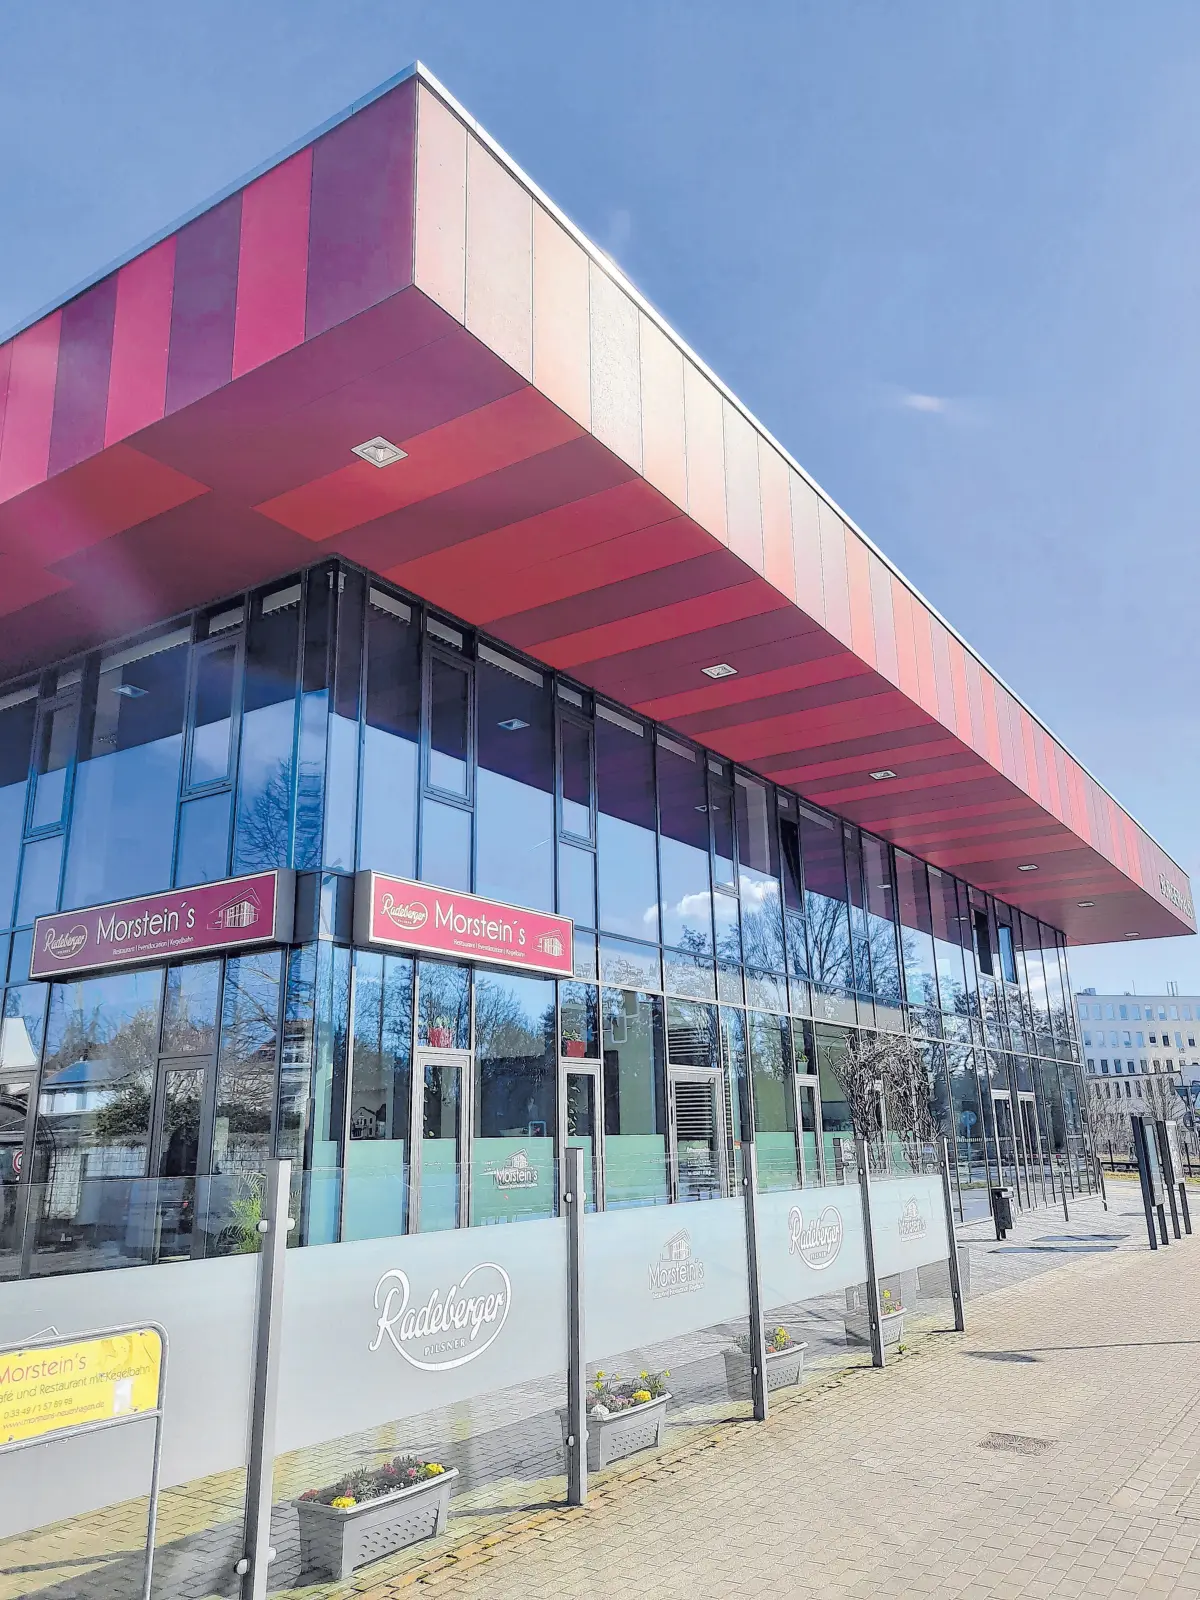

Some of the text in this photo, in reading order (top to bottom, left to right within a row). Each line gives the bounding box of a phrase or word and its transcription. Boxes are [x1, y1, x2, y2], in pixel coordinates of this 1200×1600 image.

[788, 1205, 843, 1270] Radeberger
[368, 1262, 511, 1371] Radeberger
[423, 1337, 466, 1356] PILSNER
[0, 1390, 14, 1404] afé
[17, 1384, 38, 1400] und
[40, 1377, 87, 1395] Restaurant
[105, 1365, 151, 1382] Kegelbahn
